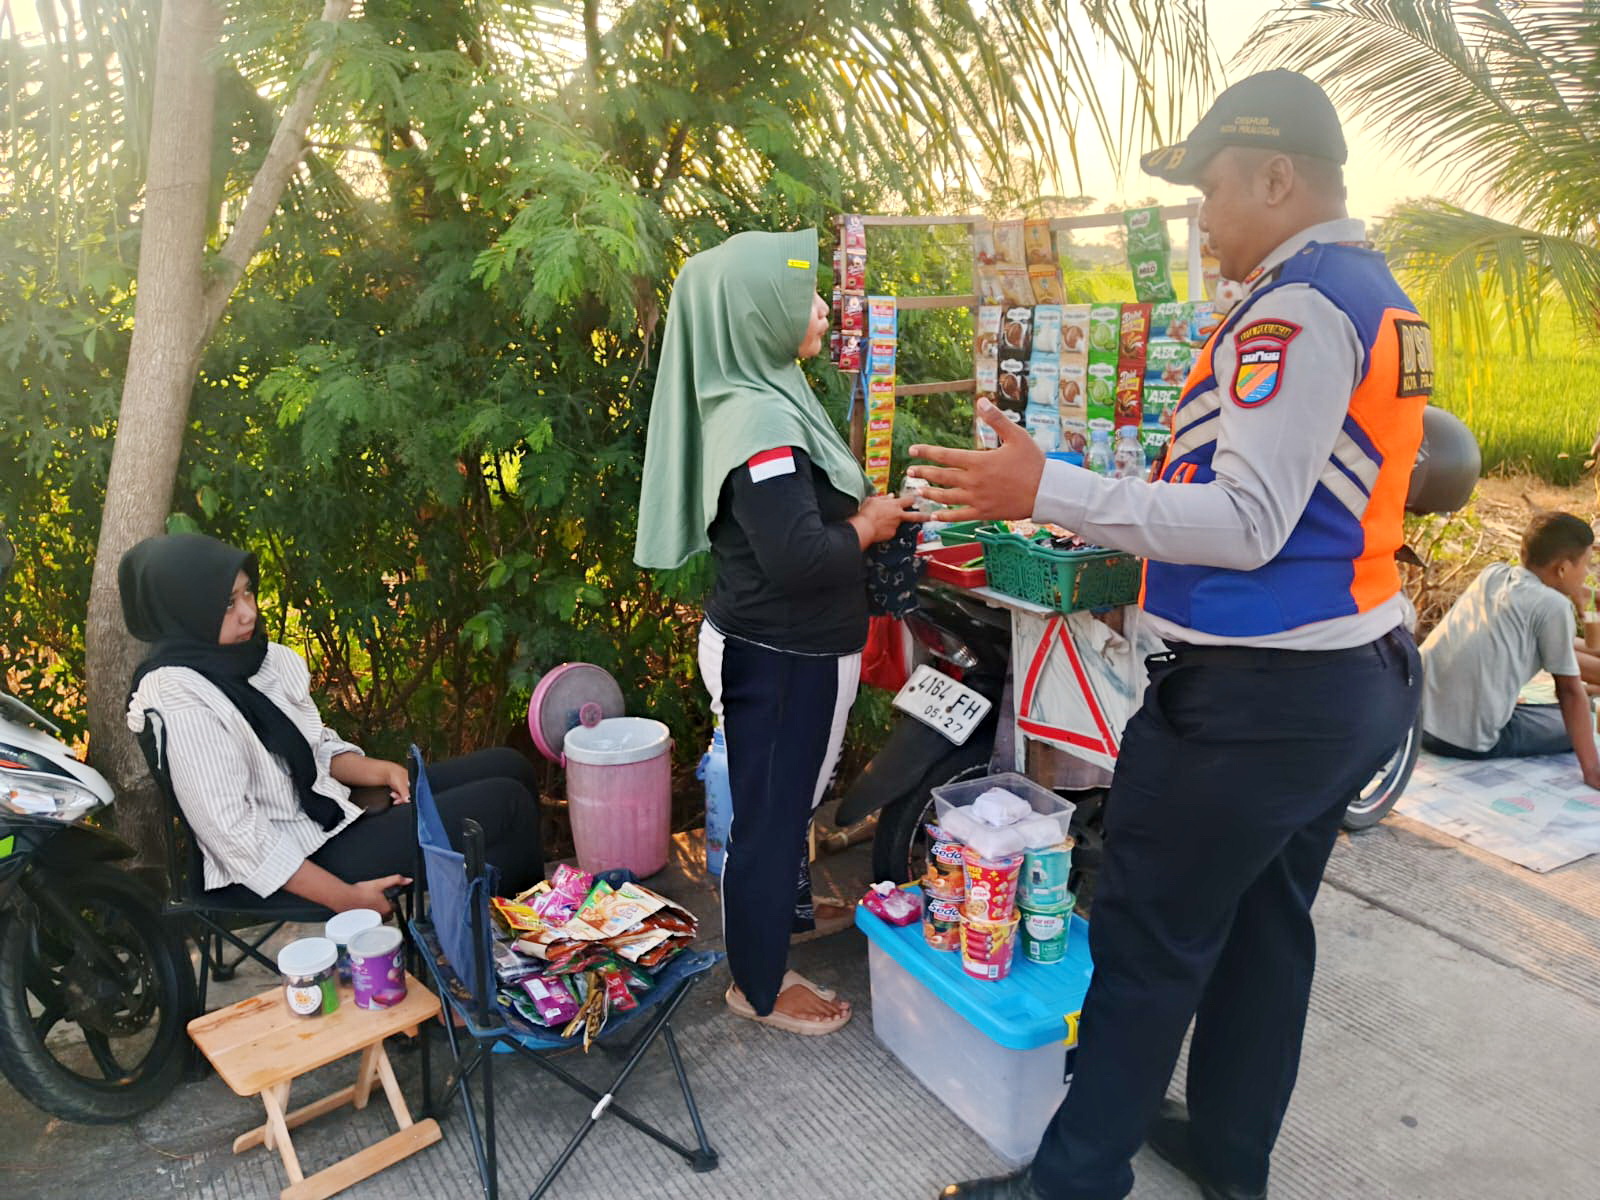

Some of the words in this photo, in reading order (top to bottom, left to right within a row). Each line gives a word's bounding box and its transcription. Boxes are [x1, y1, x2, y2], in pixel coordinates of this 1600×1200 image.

[1139, 264, 1156, 275] MILO
[1150, 347, 1178, 360] ABC
[1148, 390, 1178, 403] ABC
[918, 674, 952, 701] 4164
[950, 694, 982, 720] FH
[934, 846, 962, 859] Seda
[931, 903, 960, 916] Seda
